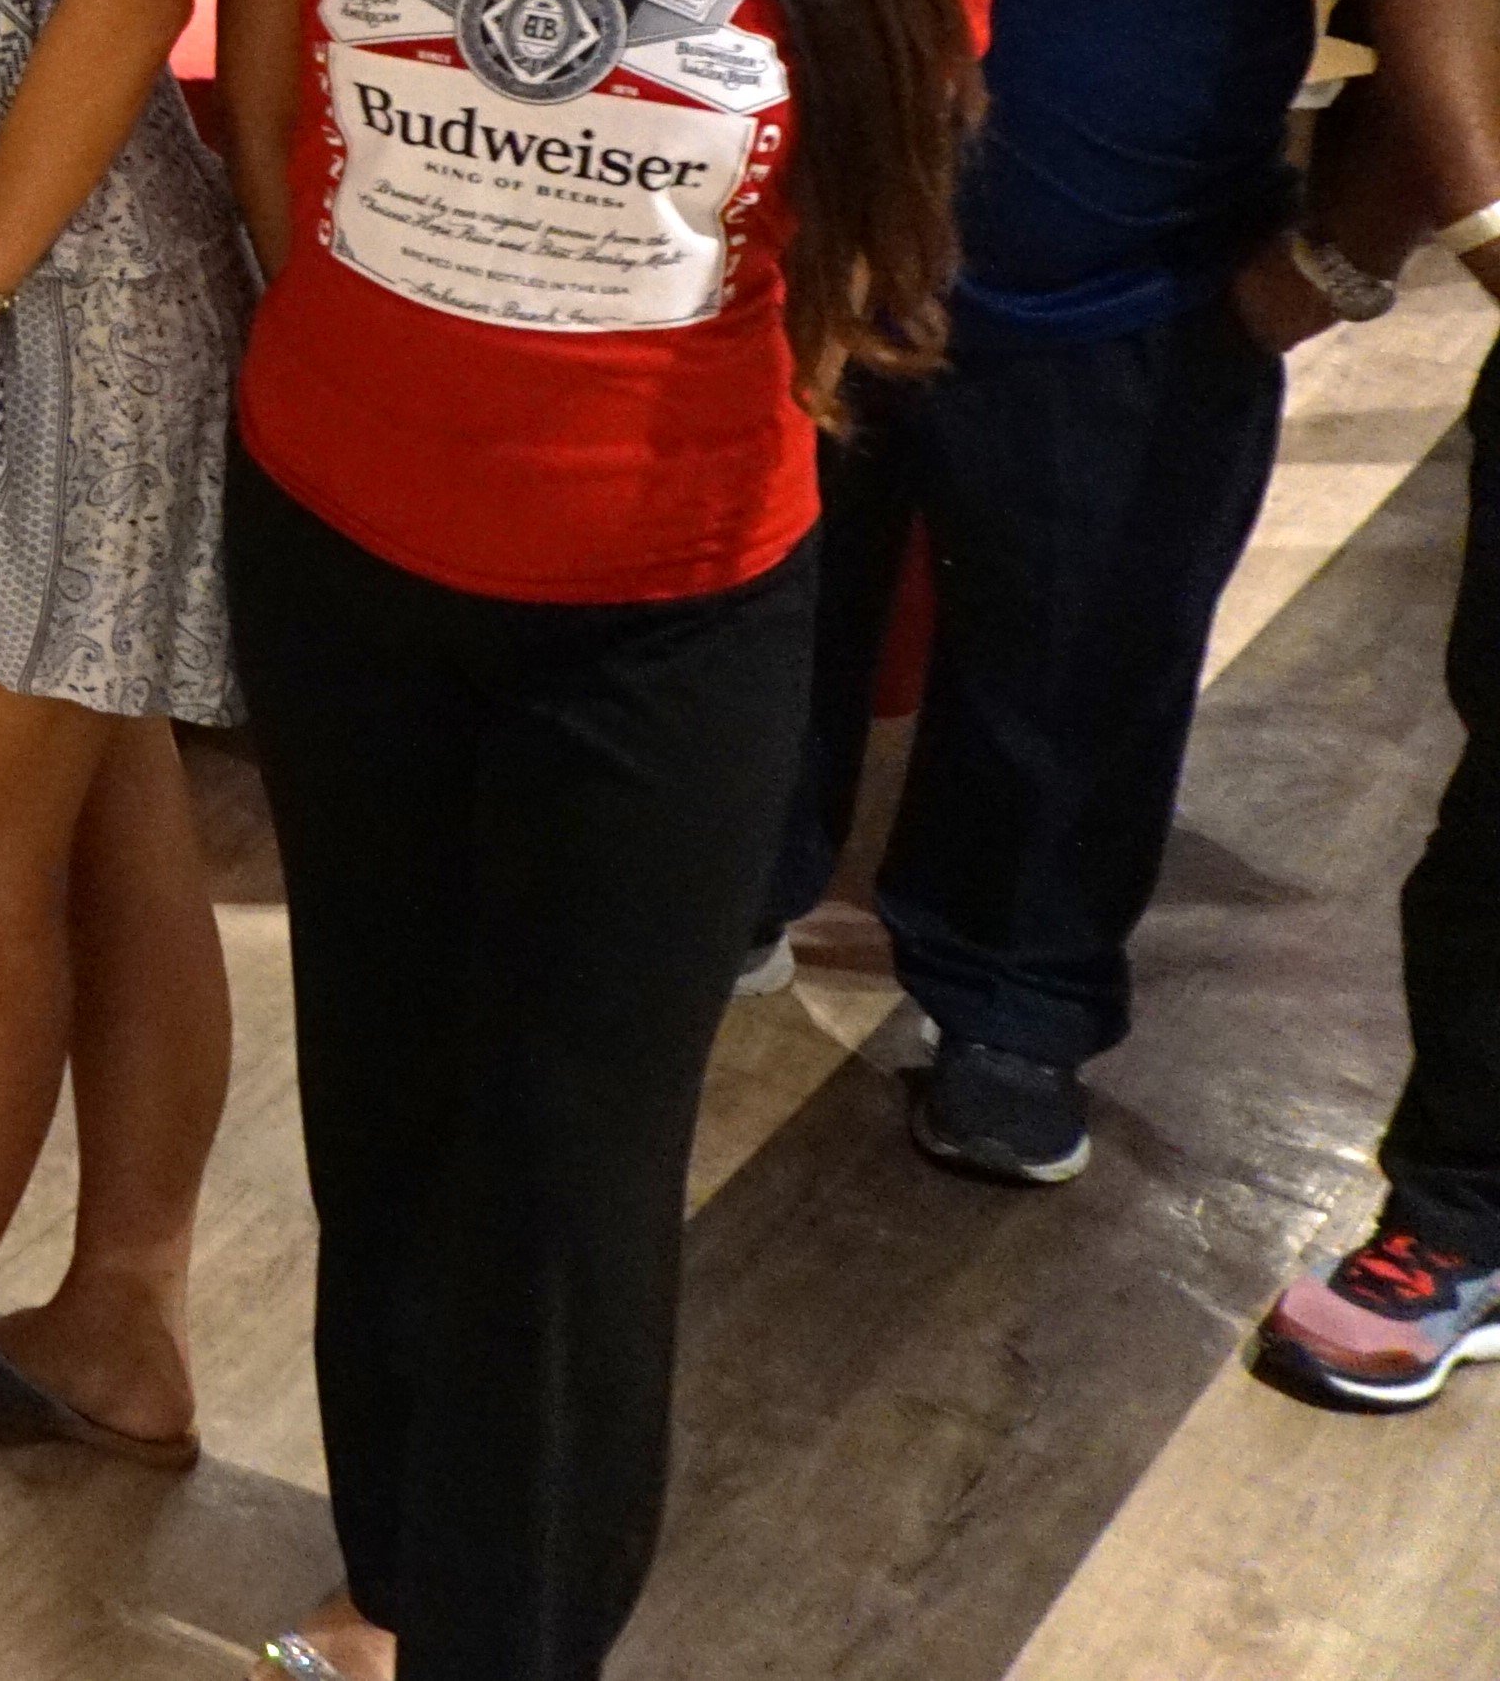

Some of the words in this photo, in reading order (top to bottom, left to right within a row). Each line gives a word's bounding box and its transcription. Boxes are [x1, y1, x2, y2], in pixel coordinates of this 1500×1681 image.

[353, 79, 710, 193] Budweiser
[424, 161, 483, 185] KING
[494, 176, 524, 191] OF
